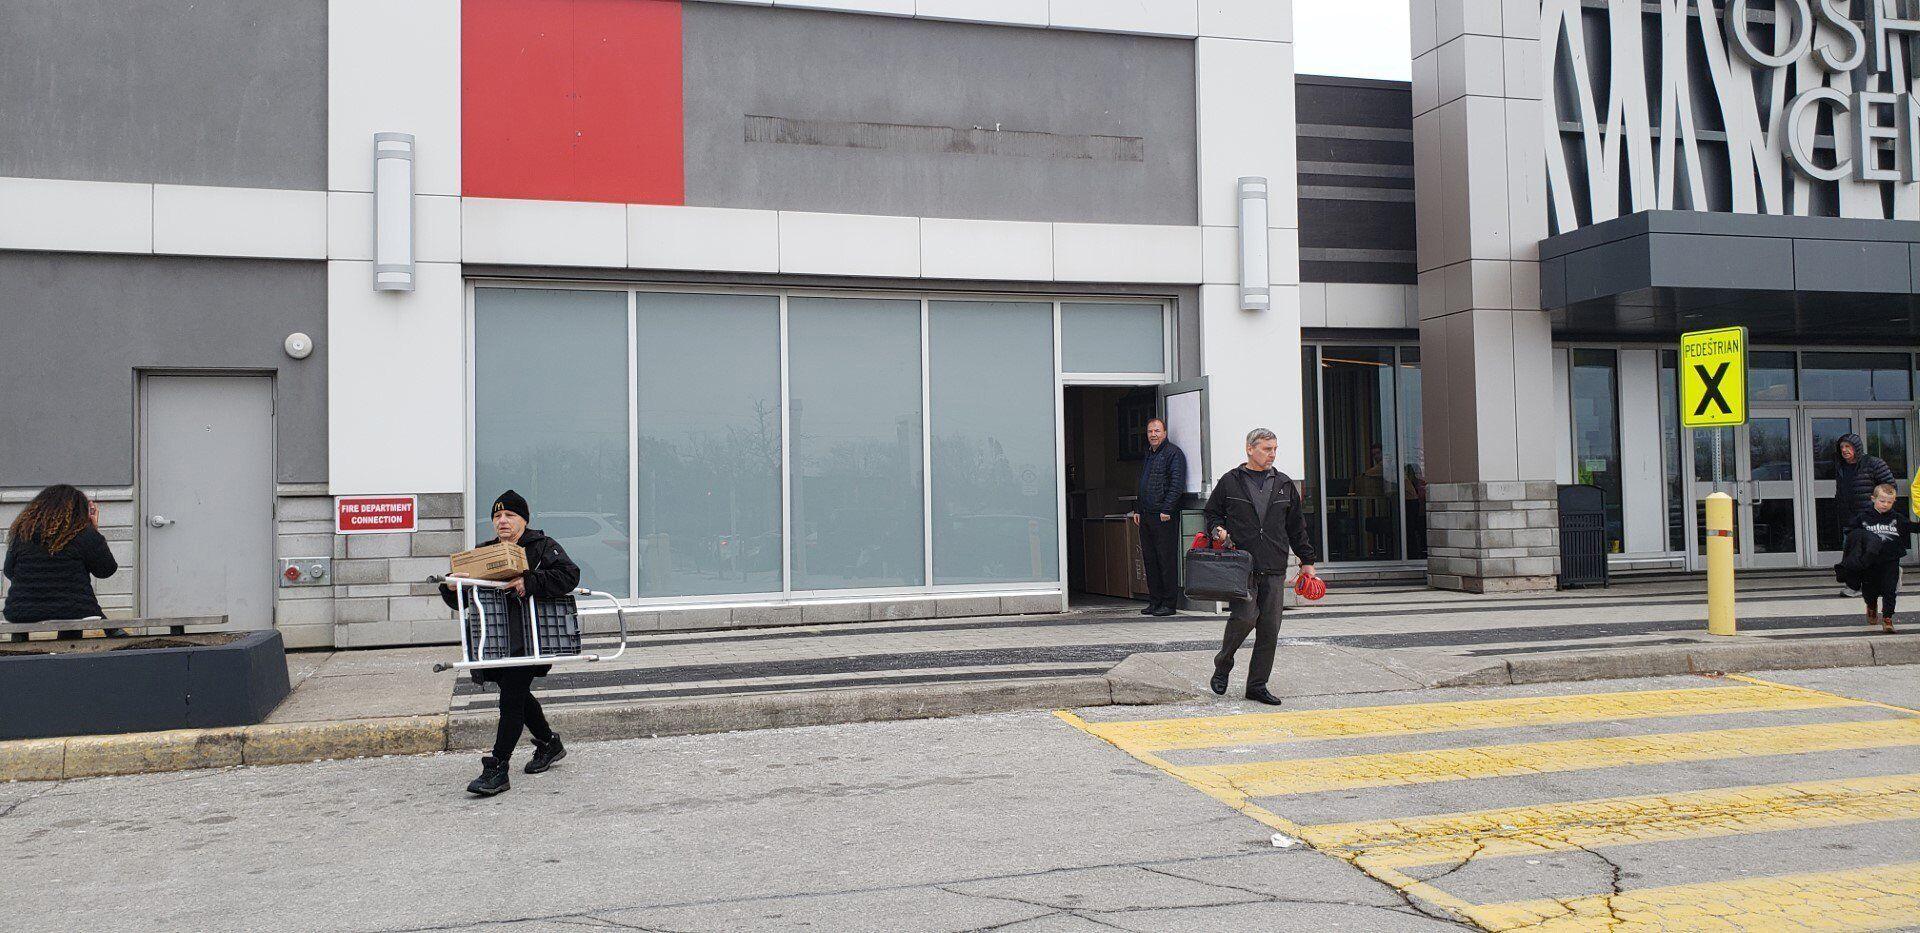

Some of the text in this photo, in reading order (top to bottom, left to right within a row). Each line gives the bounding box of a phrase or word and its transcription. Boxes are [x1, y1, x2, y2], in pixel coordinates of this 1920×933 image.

[1786, 86, 1920, 182] CE
[1685, 340, 1739, 358] PEDESTRIAN
[1693, 361, 1733, 416] X
[341, 503, 412, 514] FIRE DEPARTMENT
[351, 515, 403, 525] CONNECTION
